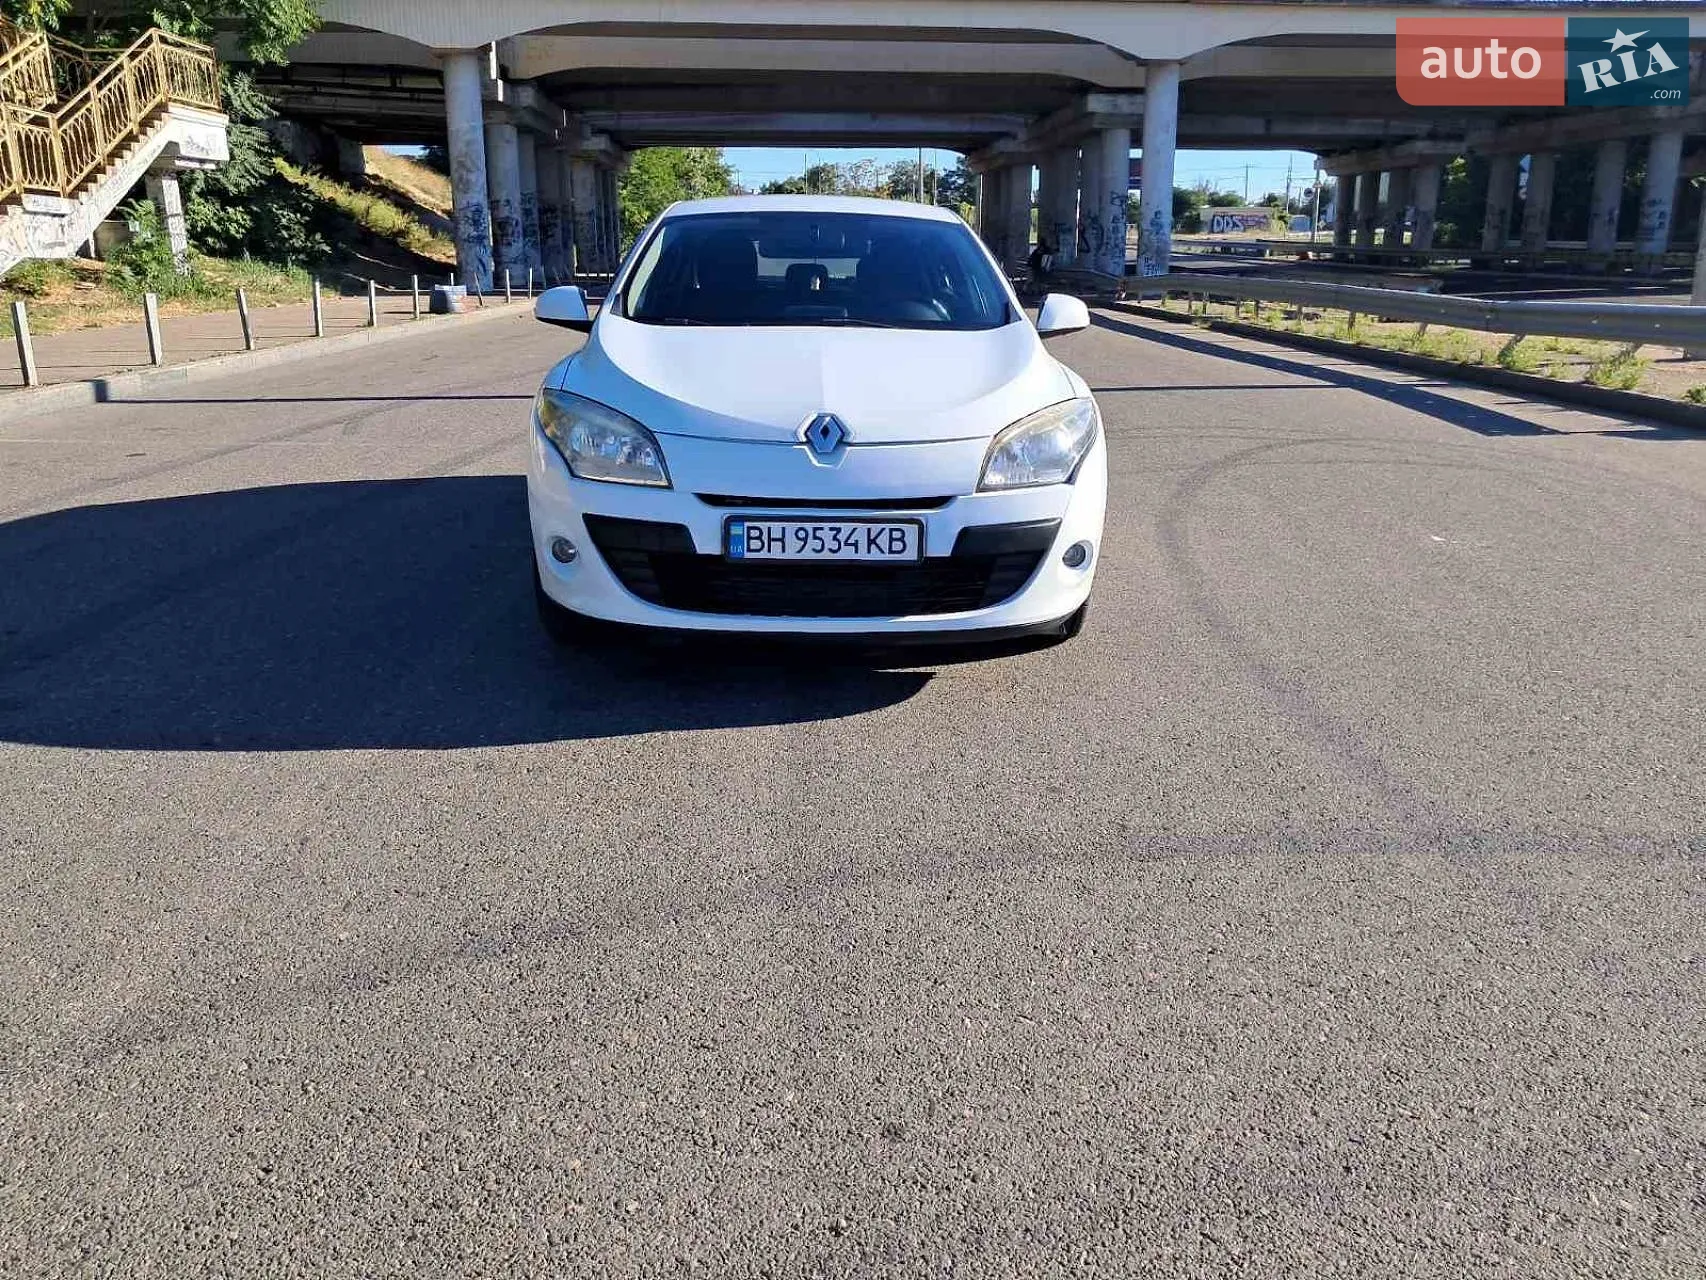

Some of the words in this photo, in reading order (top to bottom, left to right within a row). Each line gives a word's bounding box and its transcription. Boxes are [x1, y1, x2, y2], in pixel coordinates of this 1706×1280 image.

[746, 525, 786, 554] BH
[794, 526, 859, 555] 9534
[867, 527, 907, 555] KB
